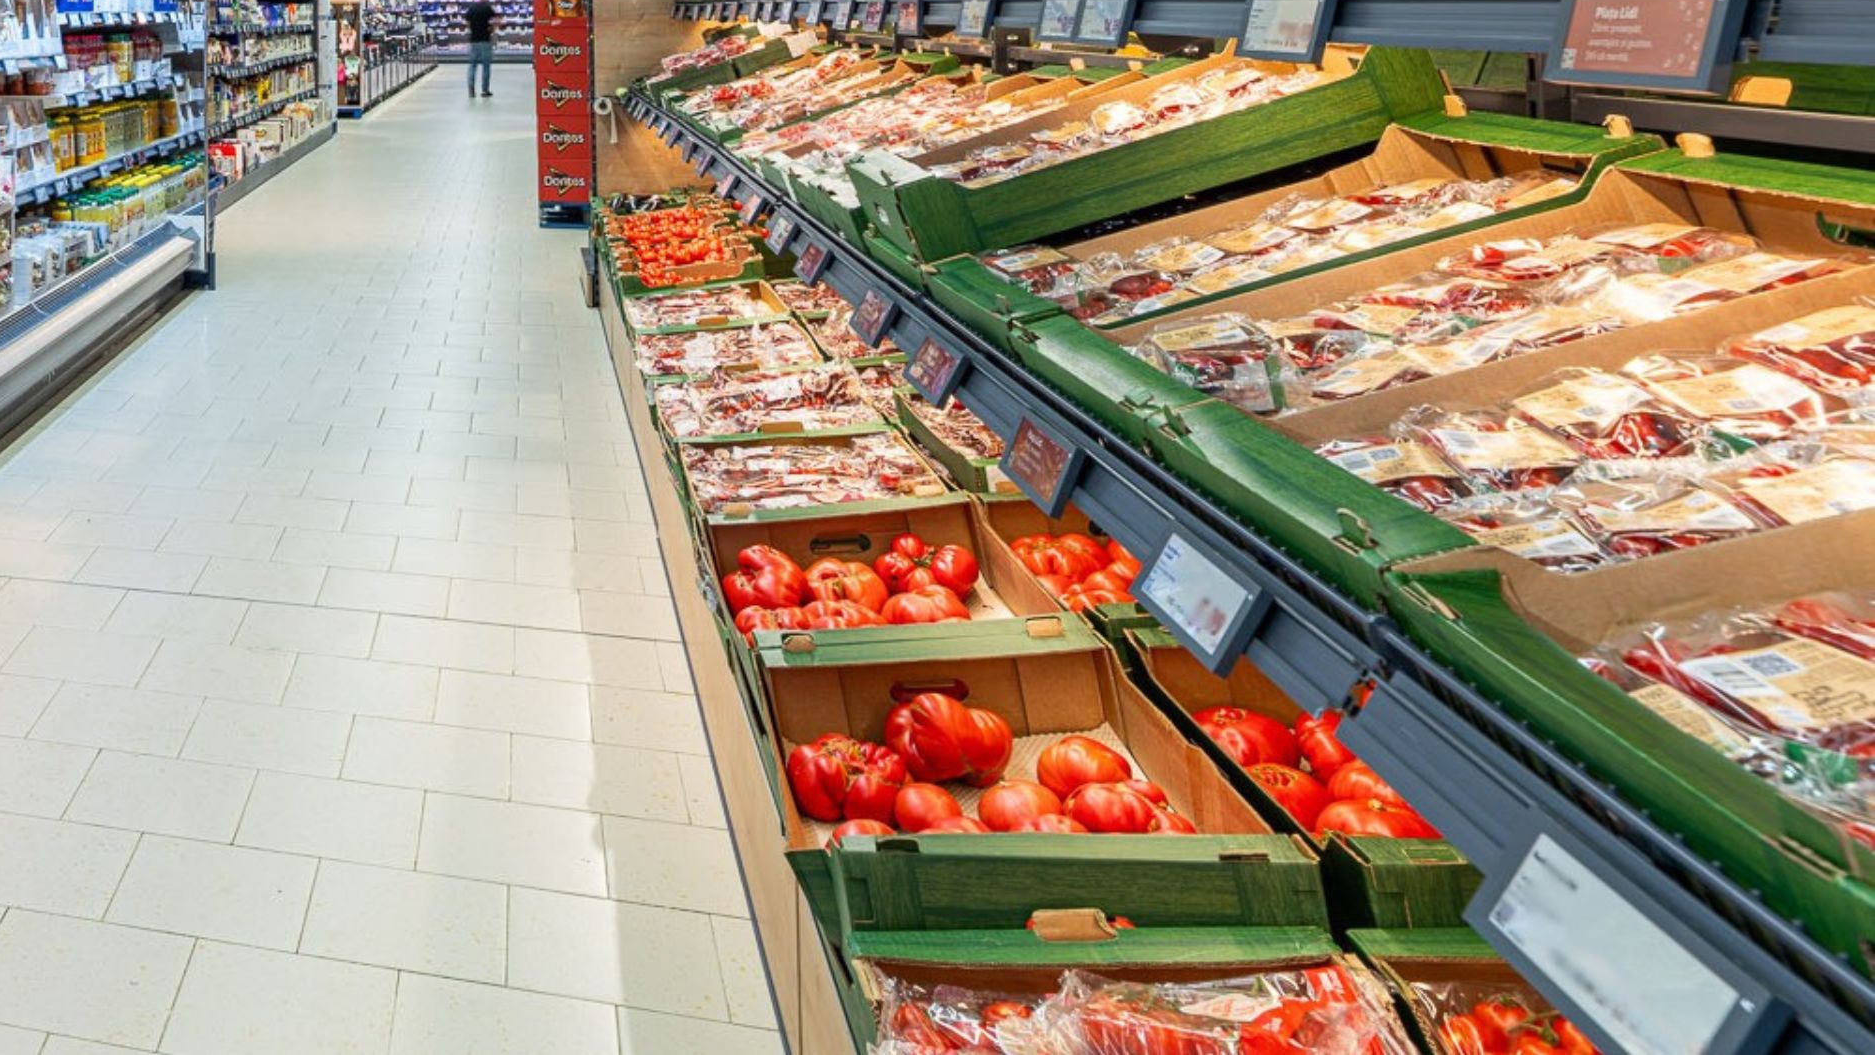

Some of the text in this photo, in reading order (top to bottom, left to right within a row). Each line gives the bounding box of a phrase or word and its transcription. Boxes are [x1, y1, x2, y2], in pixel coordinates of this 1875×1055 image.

[1619, 7, 1640, 19] Lidl
[539, 45, 581, 55] Doritos
[541, 89, 583, 99] Doritos
[543, 133, 584, 143] Doritos
[544, 176, 585, 187] Doritos
